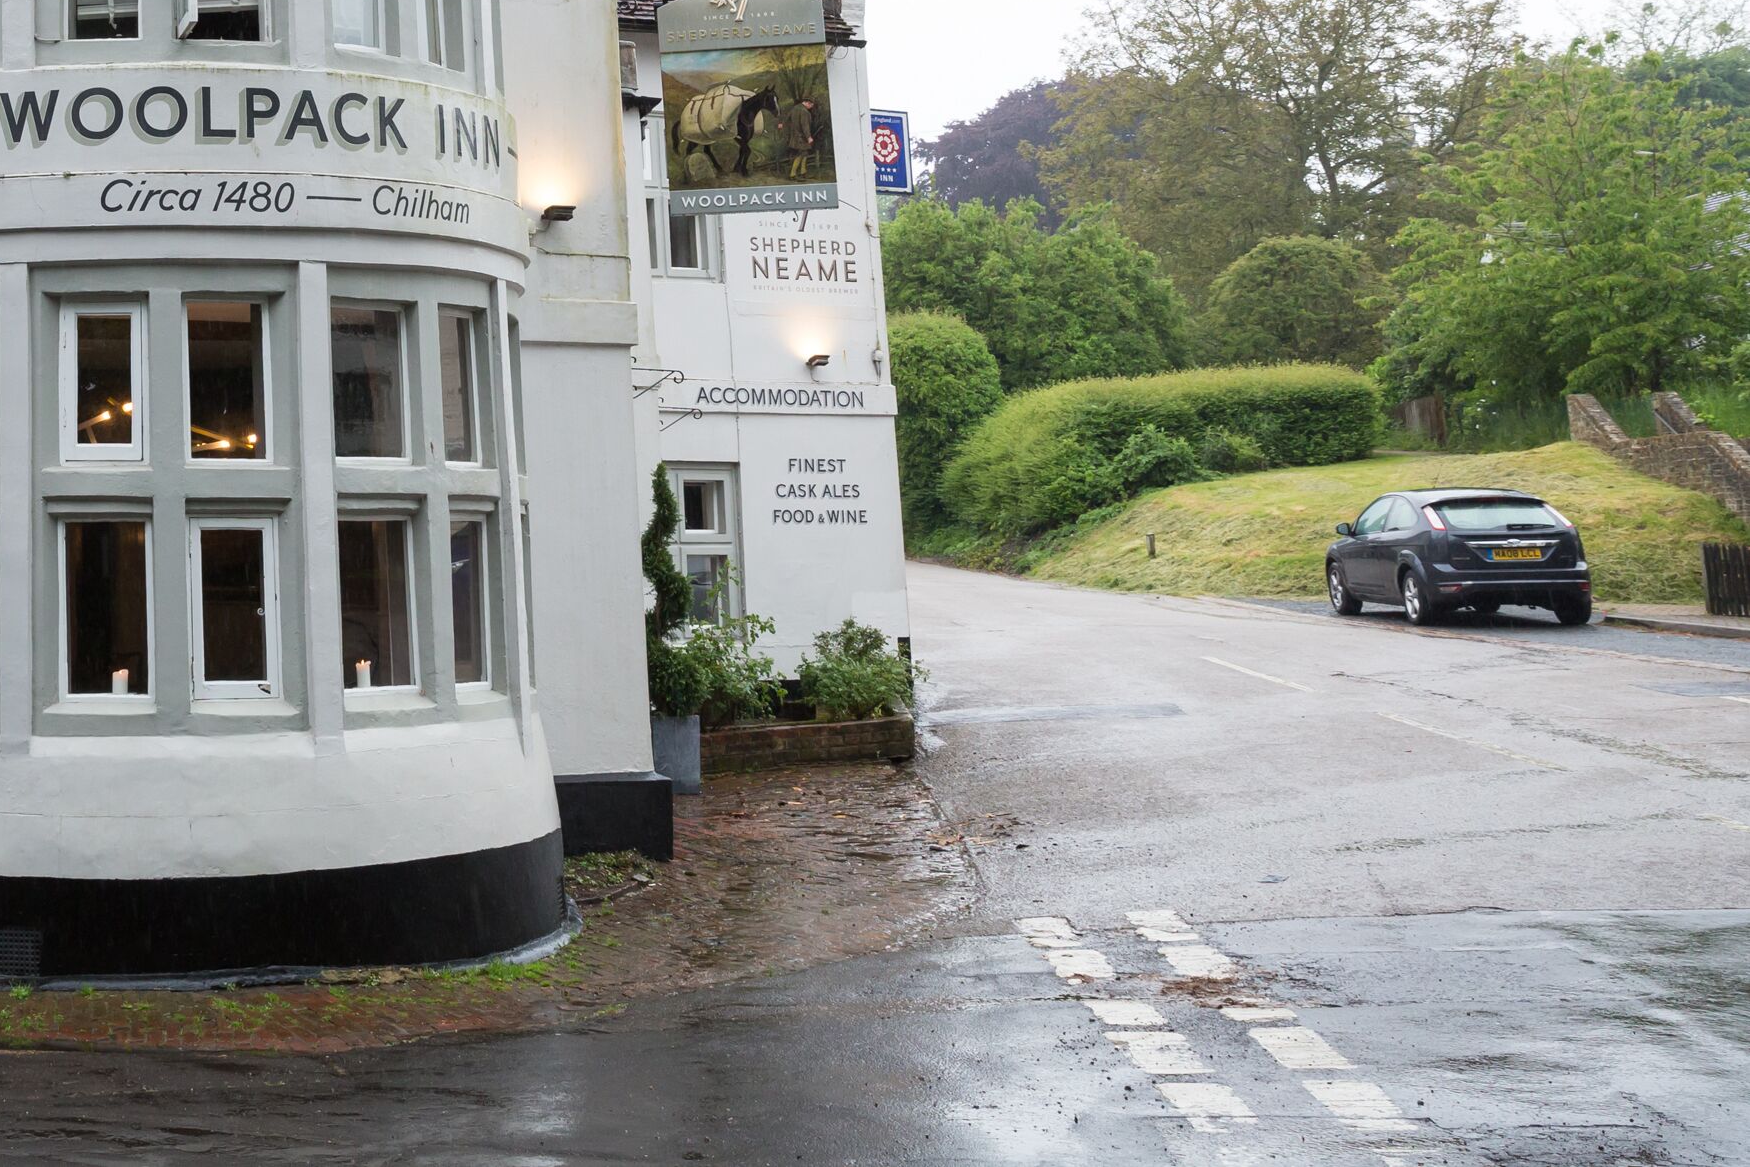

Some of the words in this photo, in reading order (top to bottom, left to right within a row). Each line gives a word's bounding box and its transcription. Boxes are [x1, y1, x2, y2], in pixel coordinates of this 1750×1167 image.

[666, 26, 752, 44] SHEPHERD
[759, 22, 817, 37] NEAME
[435, 104, 500, 173] INN
[879, 174, 894, 183] INN
[100, 179, 202, 213] Circa
[212, 181, 296, 213] 1480
[372, 184, 470, 224] Chilham
[681, 192, 786, 208] WOOLPACK
[794, 190, 828, 204] INN
[758, 220, 788, 229] SINCE
[749, 236, 856, 256] SHEPHERD
[751, 255, 858, 283] NEAME
[795, 286, 825, 294] OLDEST
[696, 387, 865, 409] ACCOMMODATION
[788, 458, 847, 473] FINEST
[775, 483, 818, 499] CASK
[822, 484, 861, 499] ALES
[772, 509, 815, 524] FOOD
[826, 509, 869, 524] WINE
